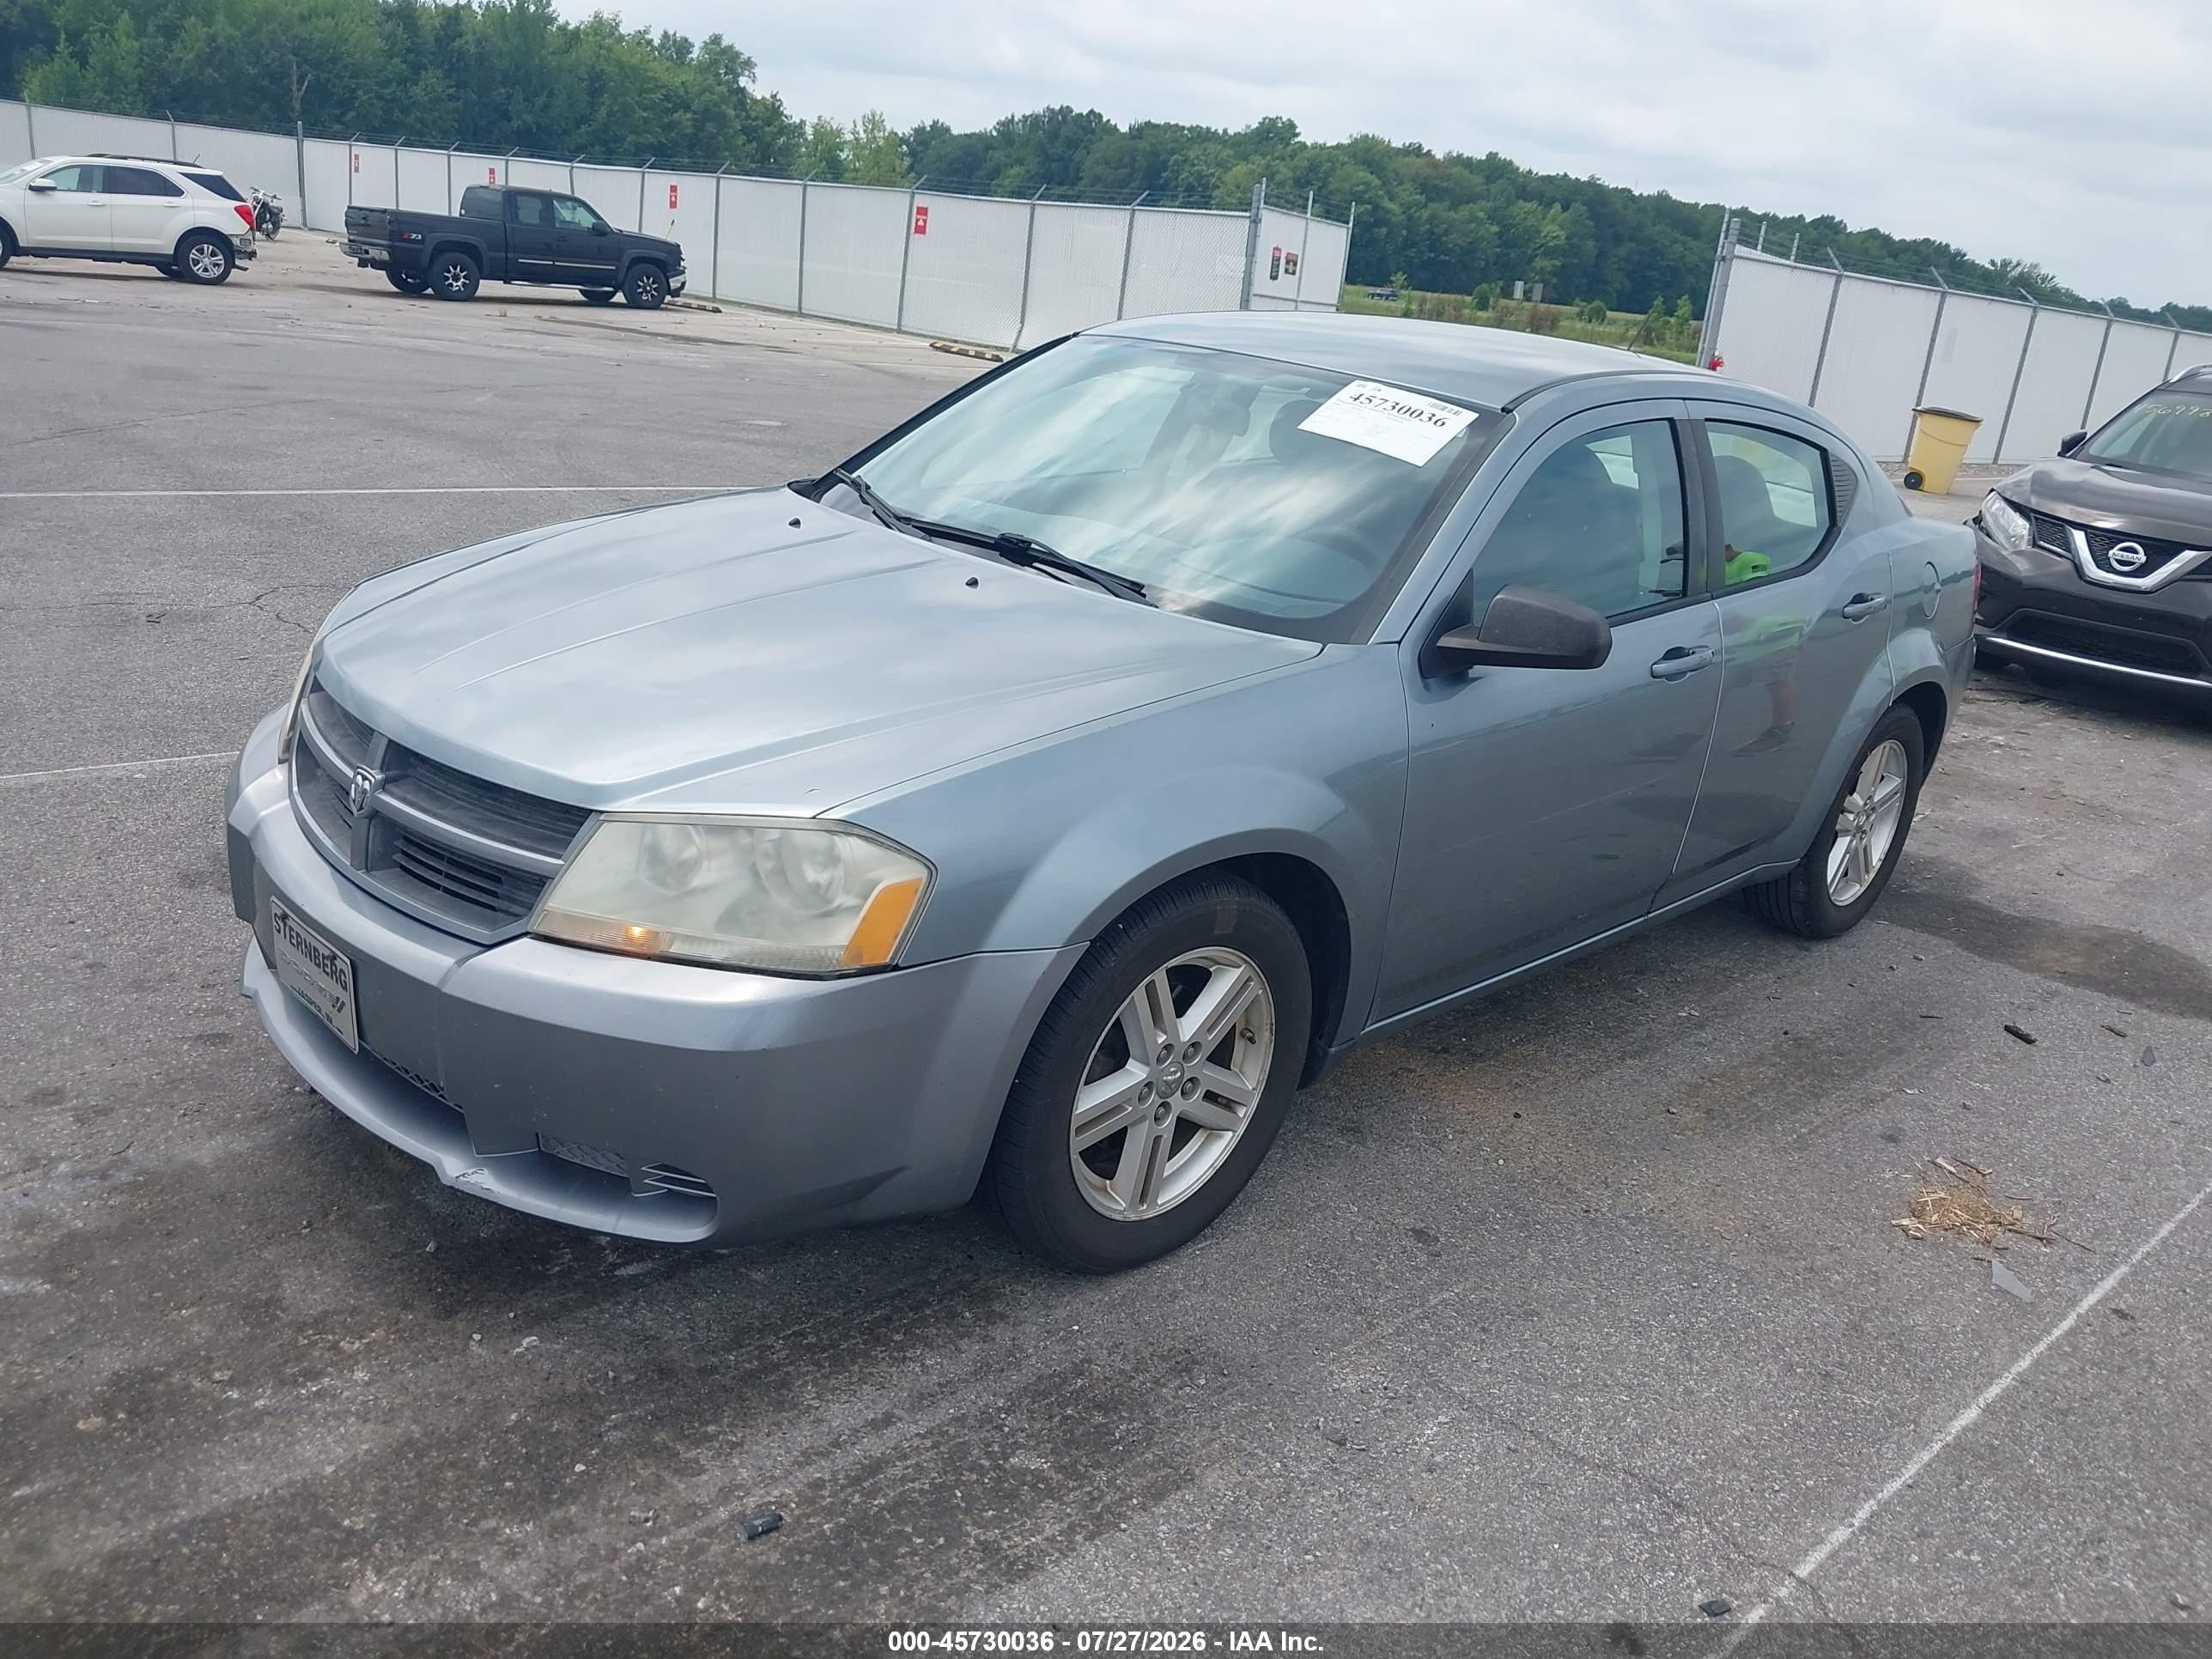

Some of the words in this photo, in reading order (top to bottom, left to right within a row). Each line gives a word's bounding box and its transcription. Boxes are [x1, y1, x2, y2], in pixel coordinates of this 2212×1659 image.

[1349, 392, 1449, 428] 45730036
[2112, 552, 2142, 562] NISSAN
[274, 912, 348, 993] STERNBERG
